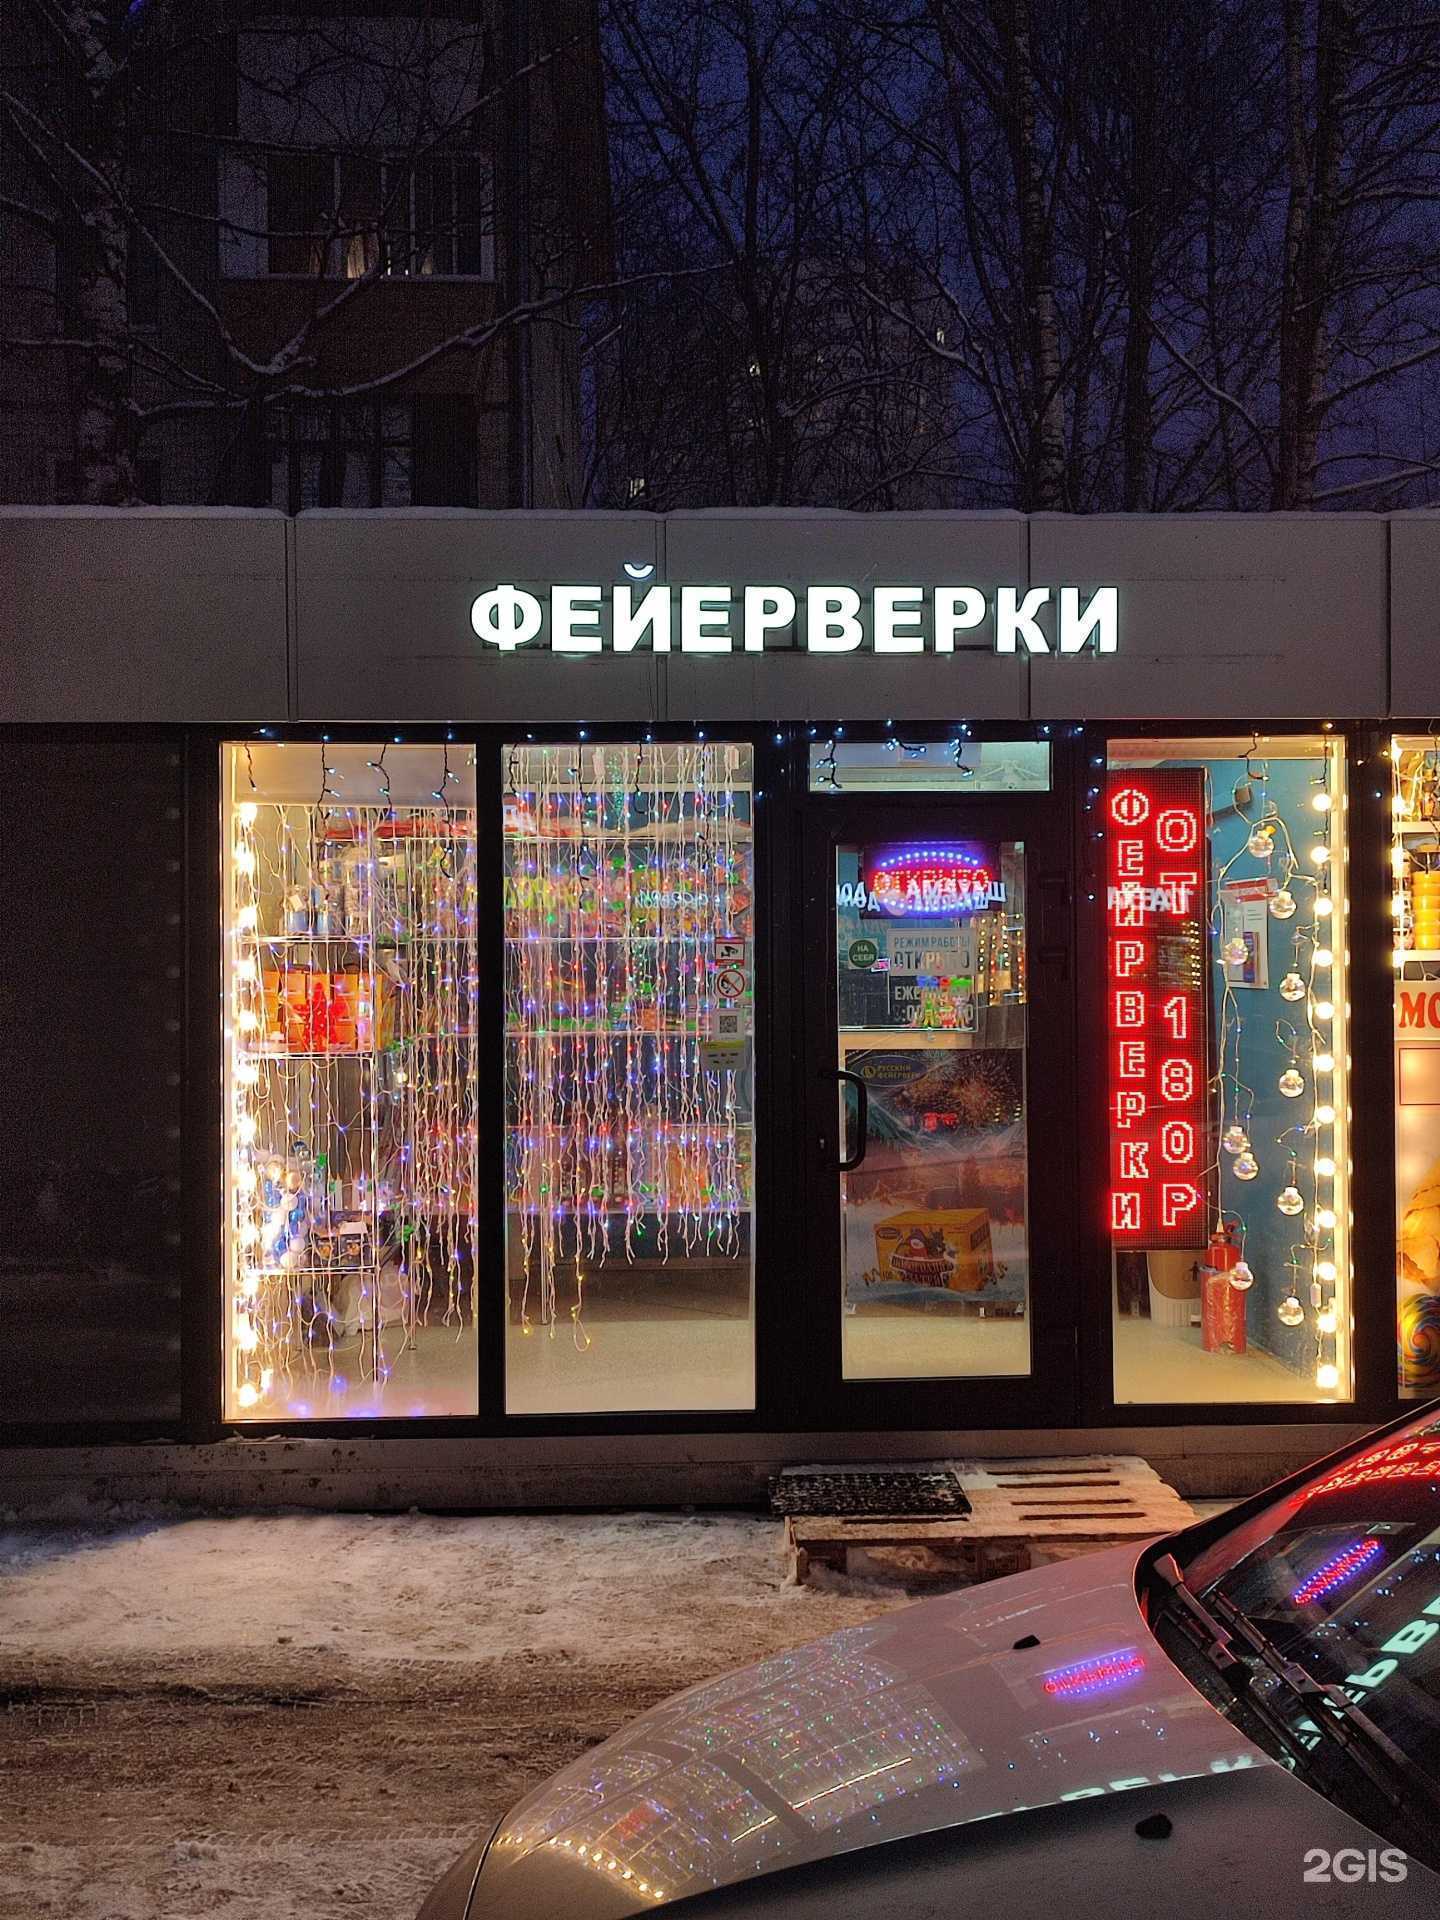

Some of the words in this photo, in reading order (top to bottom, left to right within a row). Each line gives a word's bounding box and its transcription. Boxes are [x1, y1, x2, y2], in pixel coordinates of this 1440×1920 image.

[470, 562, 1119, 654] ФЕЙЕРВЕРКИ
[894, 937, 929, 948] РЕЖИМ
[857, 945, 869, 953] НА
